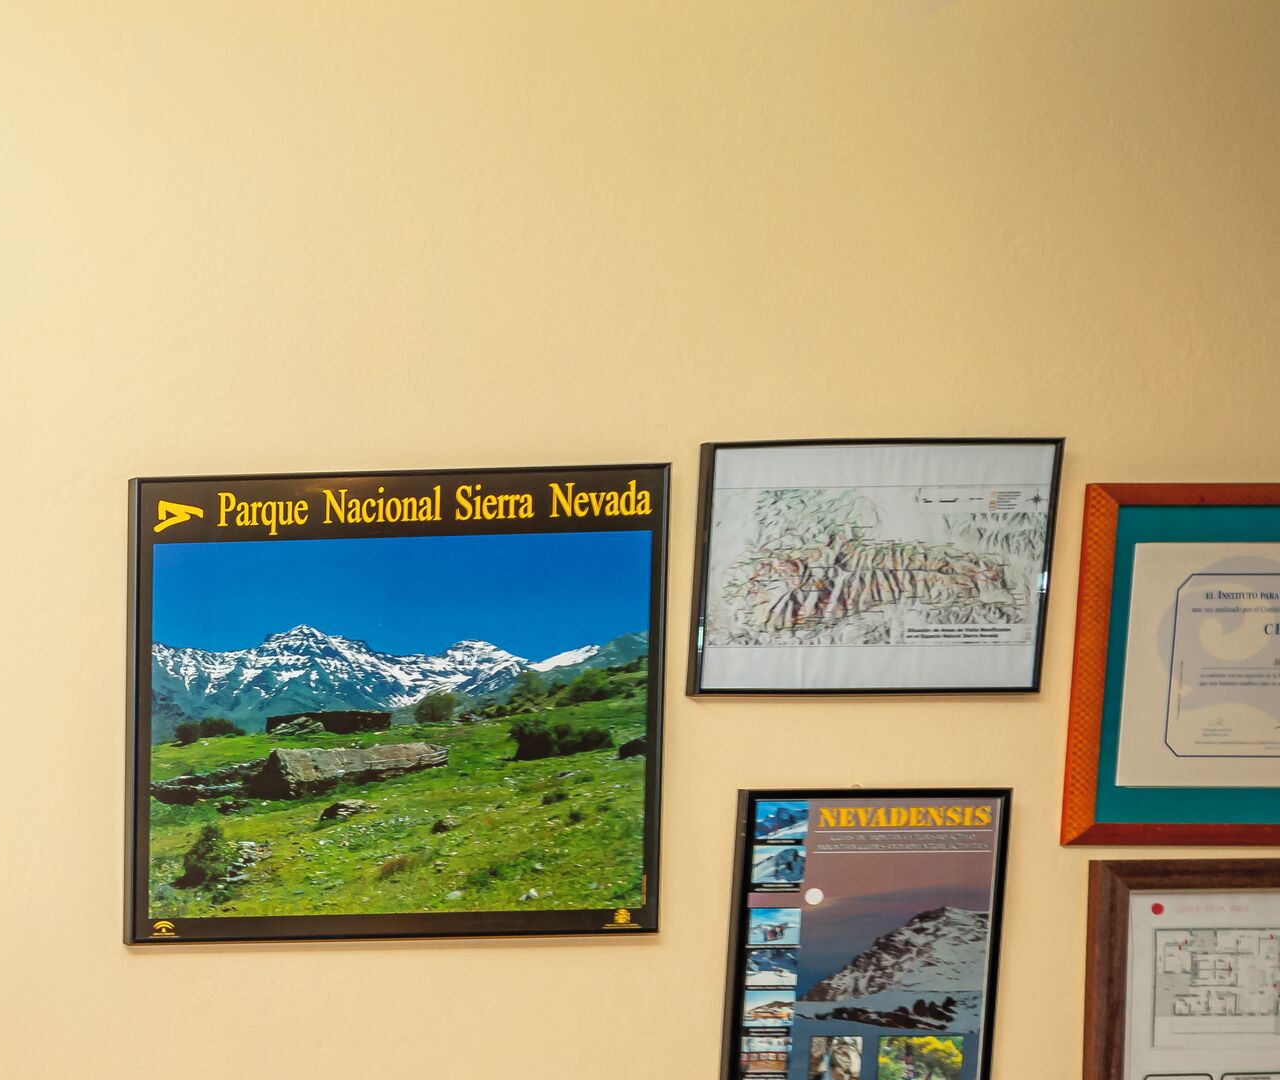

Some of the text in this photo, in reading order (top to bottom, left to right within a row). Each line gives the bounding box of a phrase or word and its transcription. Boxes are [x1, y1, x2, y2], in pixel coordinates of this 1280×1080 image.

[216, 480, 652, 536] Parque Nacional Sierra Nevada
[818, 805, 993, 829] NEVADENSIS
